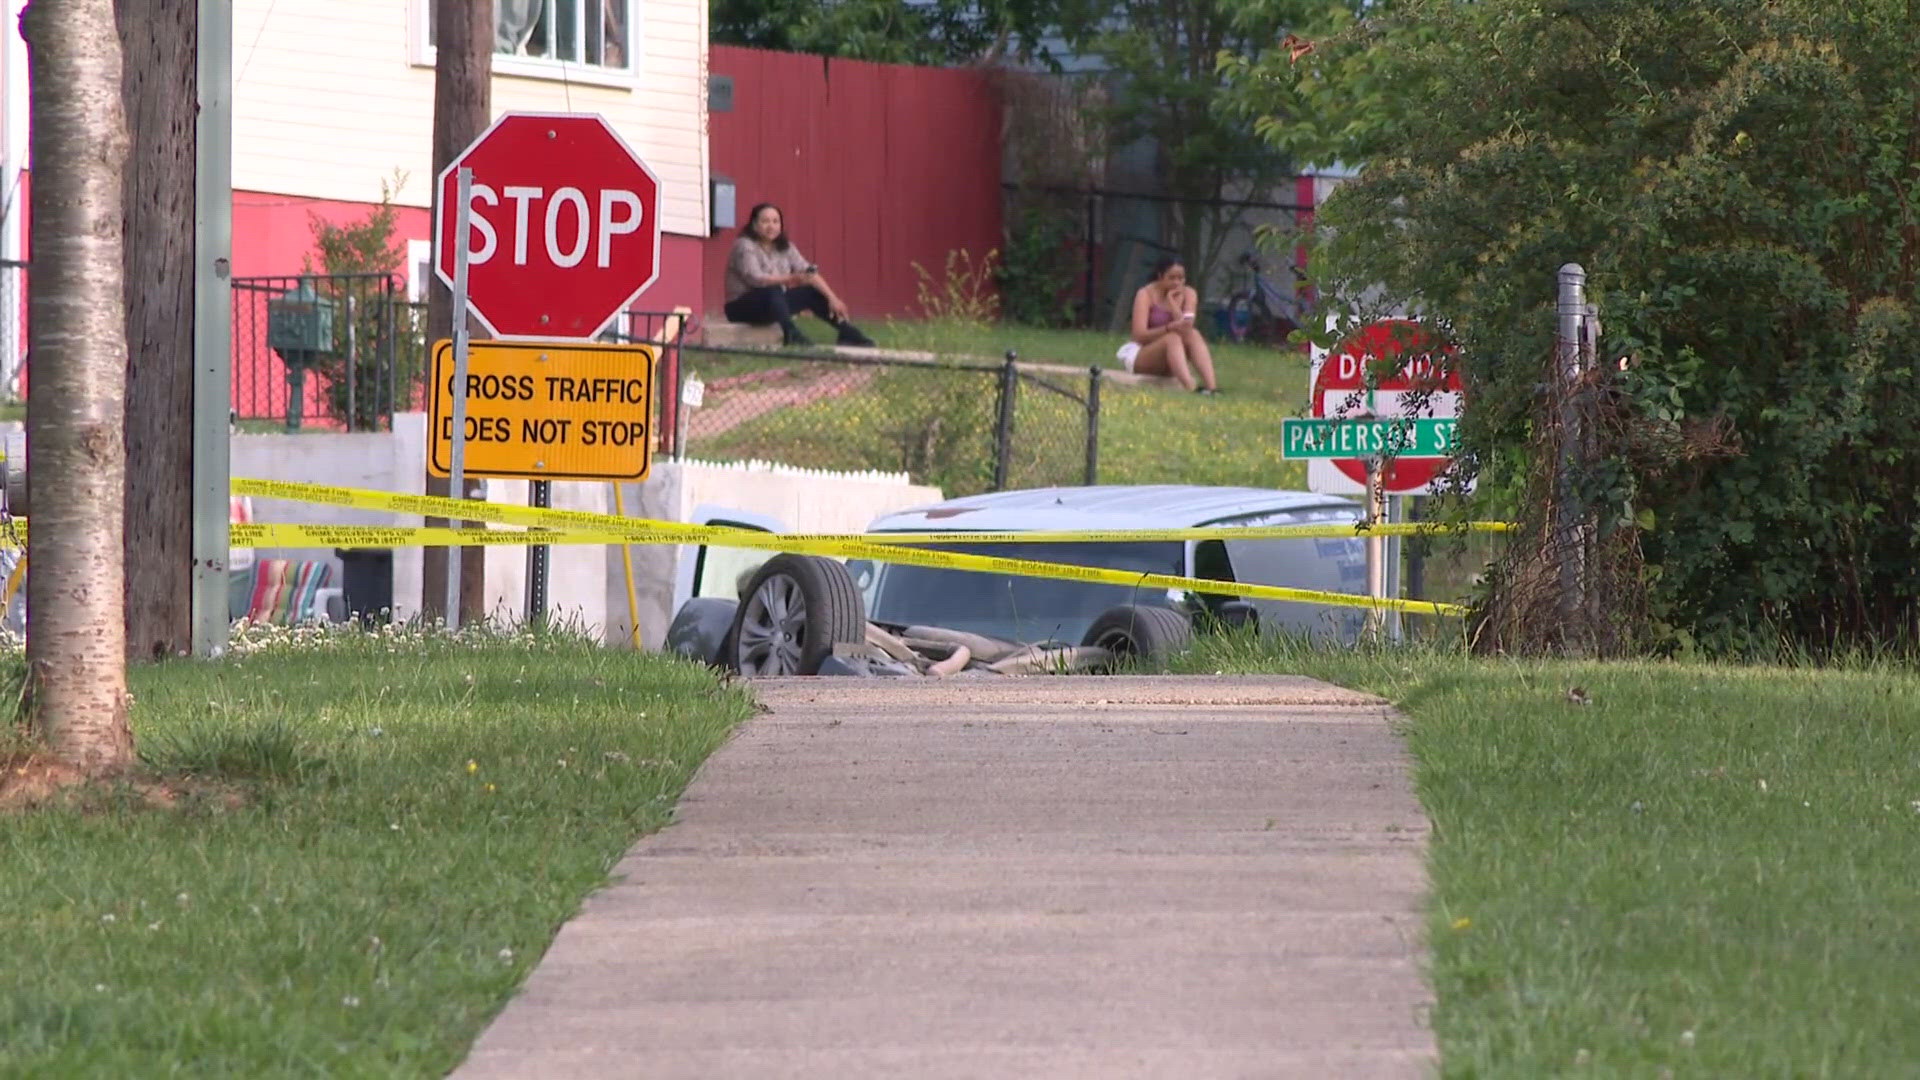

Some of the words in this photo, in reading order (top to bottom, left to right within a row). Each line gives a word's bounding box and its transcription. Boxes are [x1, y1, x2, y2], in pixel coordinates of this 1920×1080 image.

[467, 184, 643, 268] STOP
[545, 377, 643, 404] TRAFFIC
[522, 419, 571, 444] NOT
[581, 421, 644, 446] STOP
[1290, 423, 1417, 452] PATTERSON
